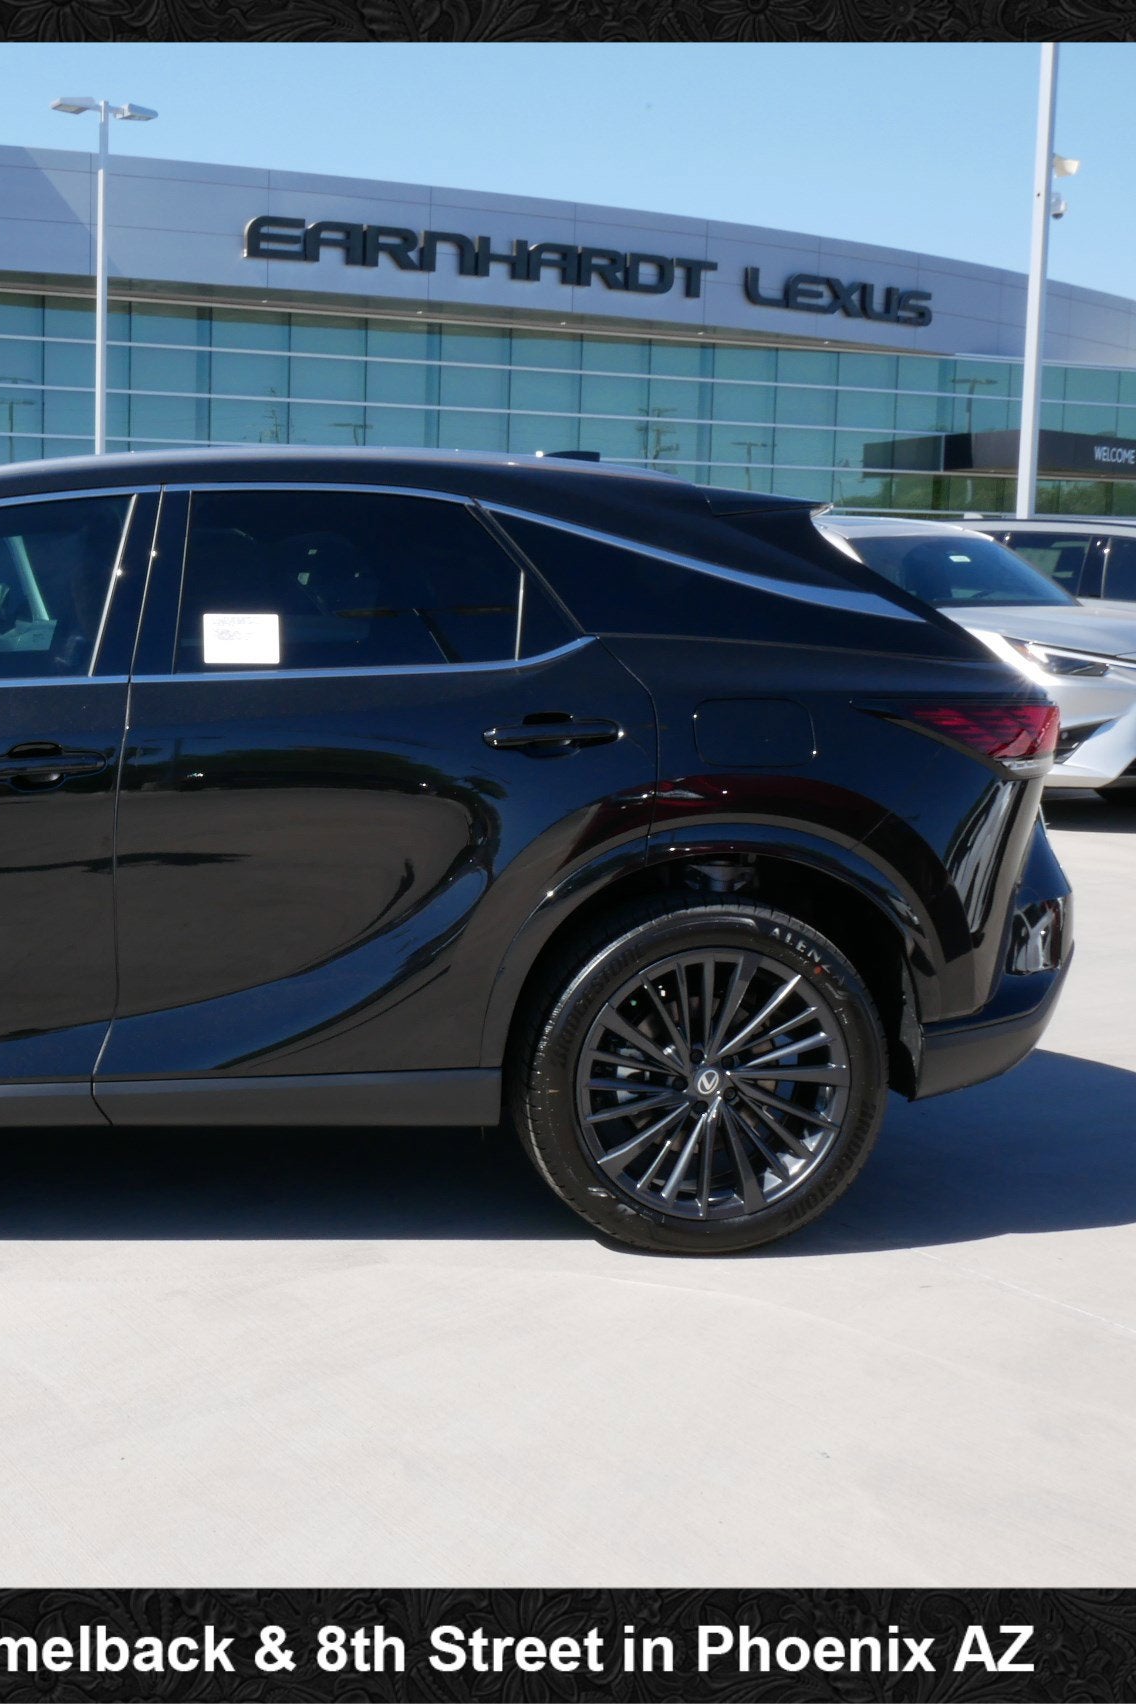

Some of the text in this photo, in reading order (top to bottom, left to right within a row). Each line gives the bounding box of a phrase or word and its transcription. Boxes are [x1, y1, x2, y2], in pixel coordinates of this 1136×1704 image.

[244, 215, 933, 326] EARNHARDT LEXUS
[1094, 446, 1136, 464] WELCOME
